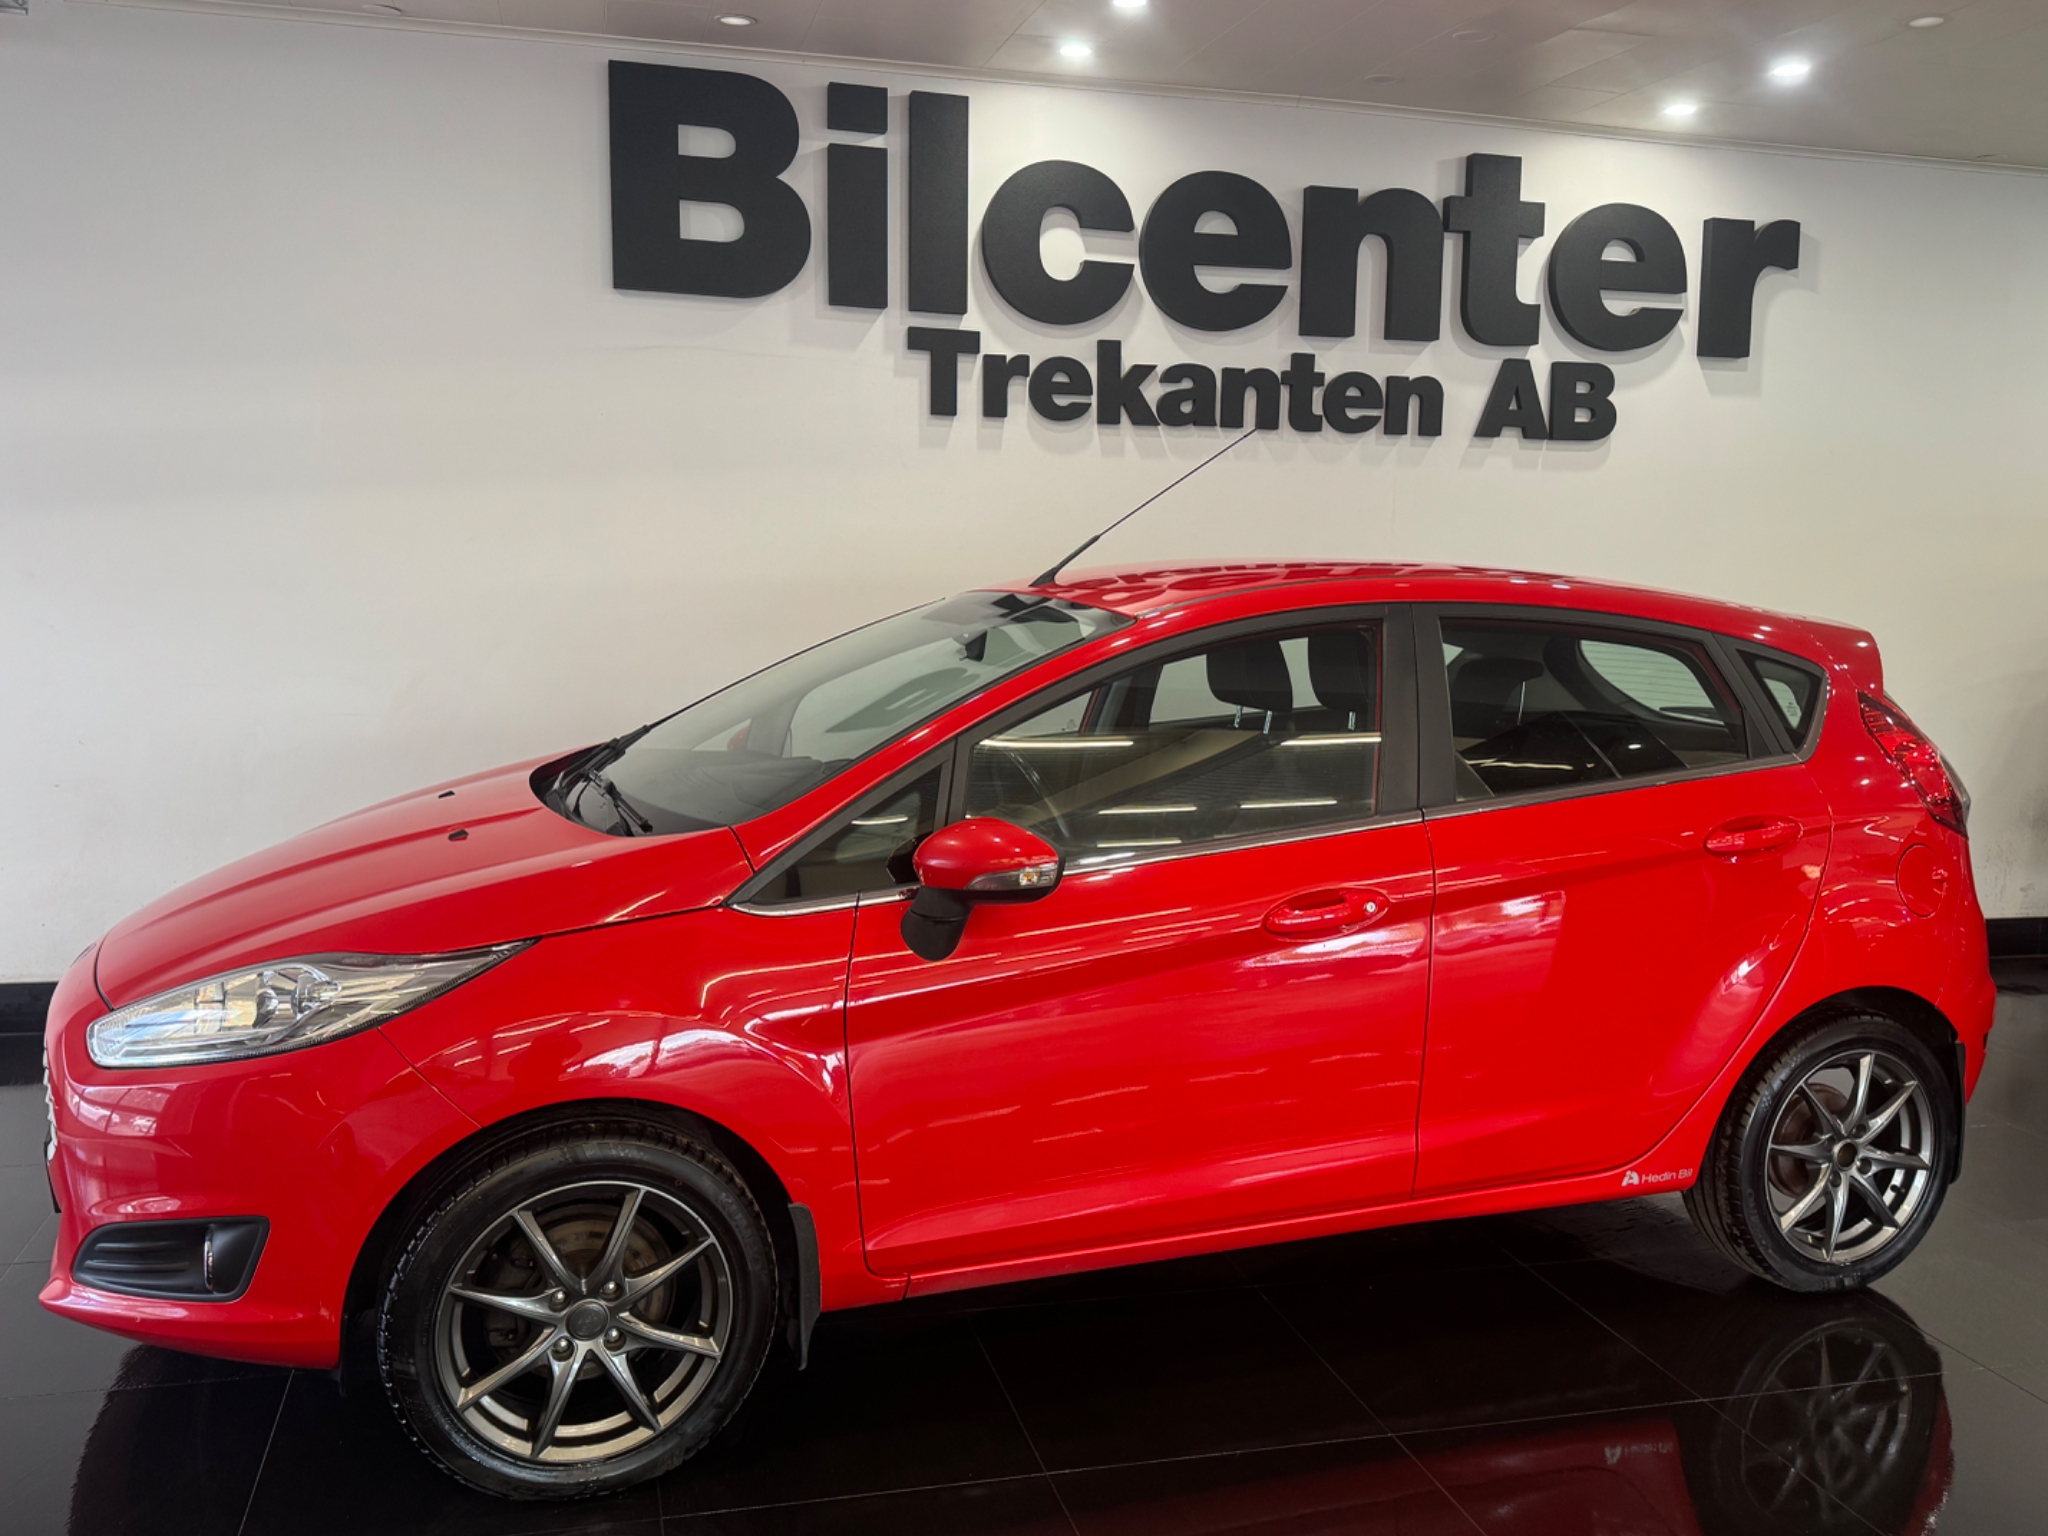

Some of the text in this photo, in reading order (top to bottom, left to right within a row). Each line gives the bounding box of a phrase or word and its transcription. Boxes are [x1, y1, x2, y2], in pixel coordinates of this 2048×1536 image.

[608, 60, 1801, 360] Bilcenter
[907, 326, 1618, 442] Trekanten AB
[1641, 1168, 1693, 1184] Hedin Bil
